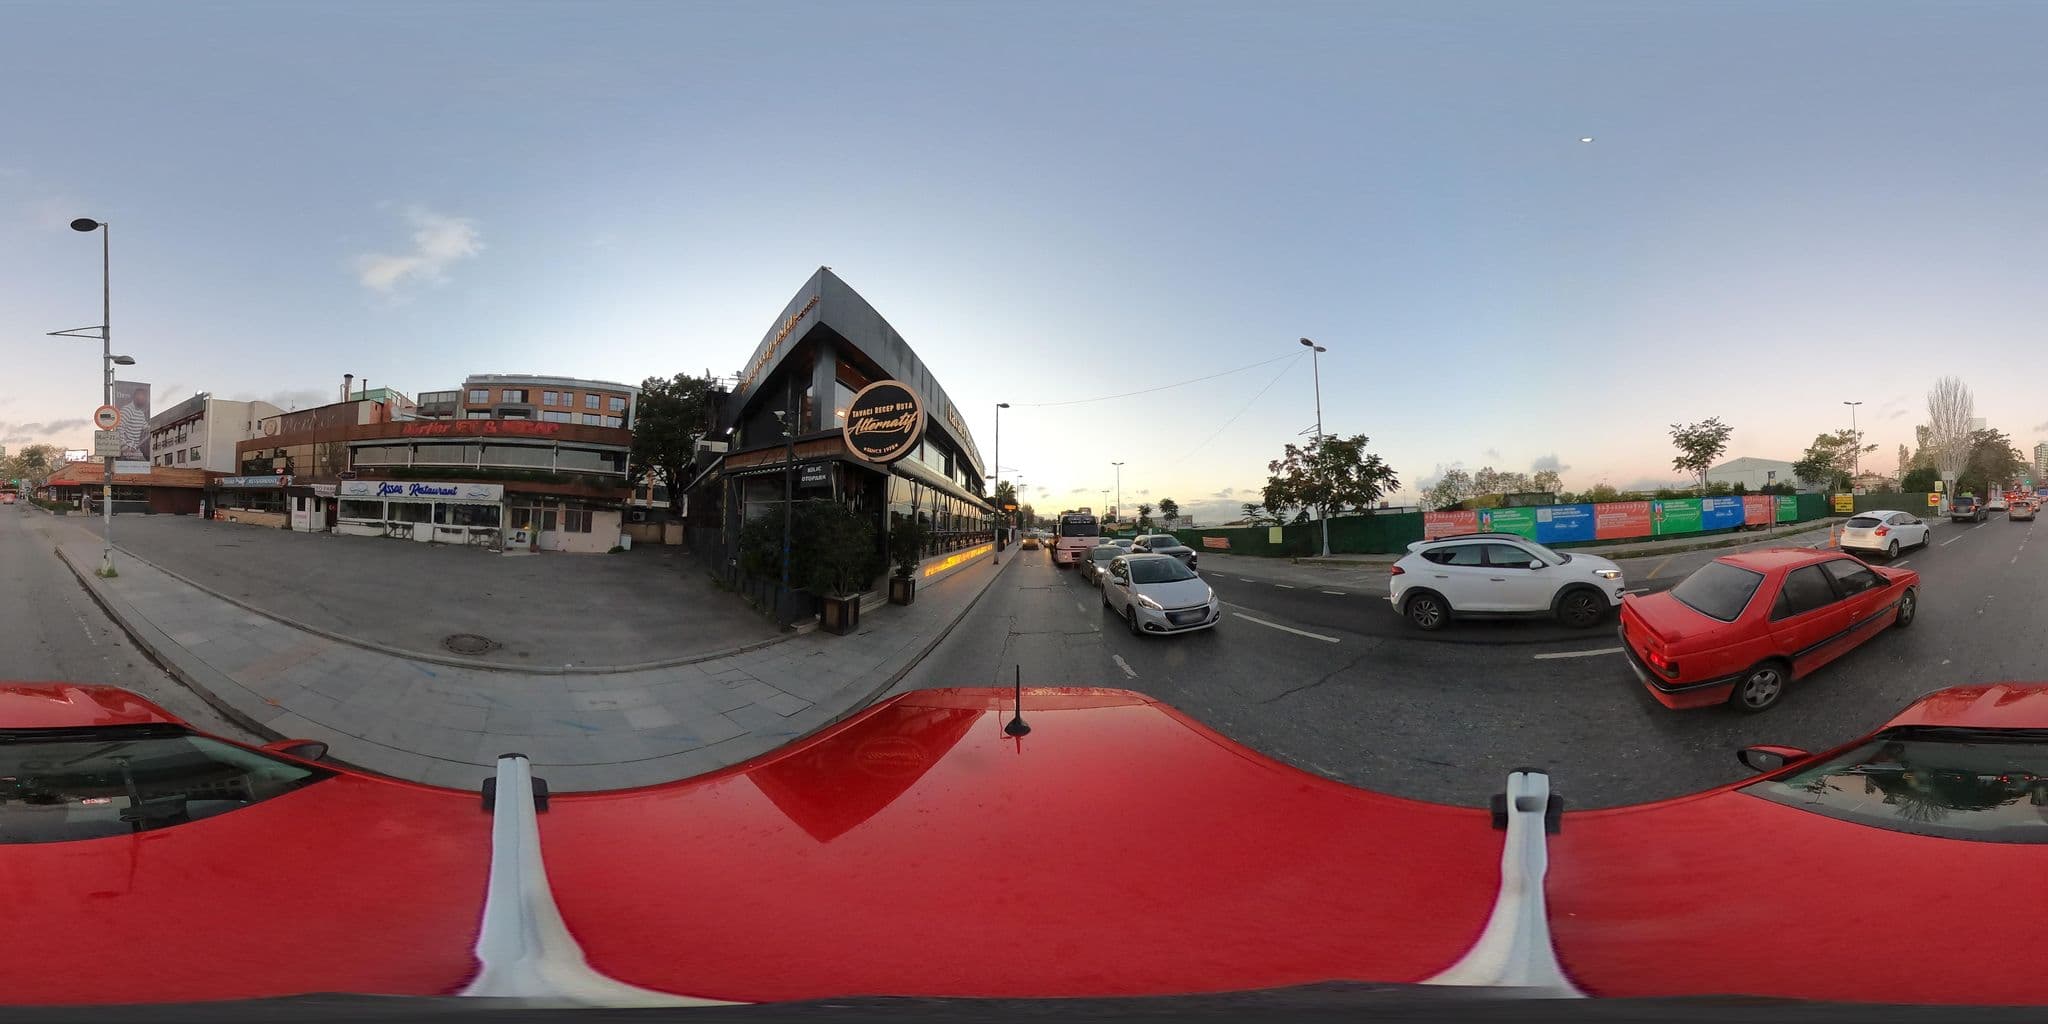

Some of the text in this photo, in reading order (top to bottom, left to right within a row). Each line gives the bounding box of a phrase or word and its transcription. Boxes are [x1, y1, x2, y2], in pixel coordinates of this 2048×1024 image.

[852, 402, 913, 418] TAVACI RECEP USTA
[847, 411, 918, 435] Alternatif
[408, 482, 459, 497] Restaurant
